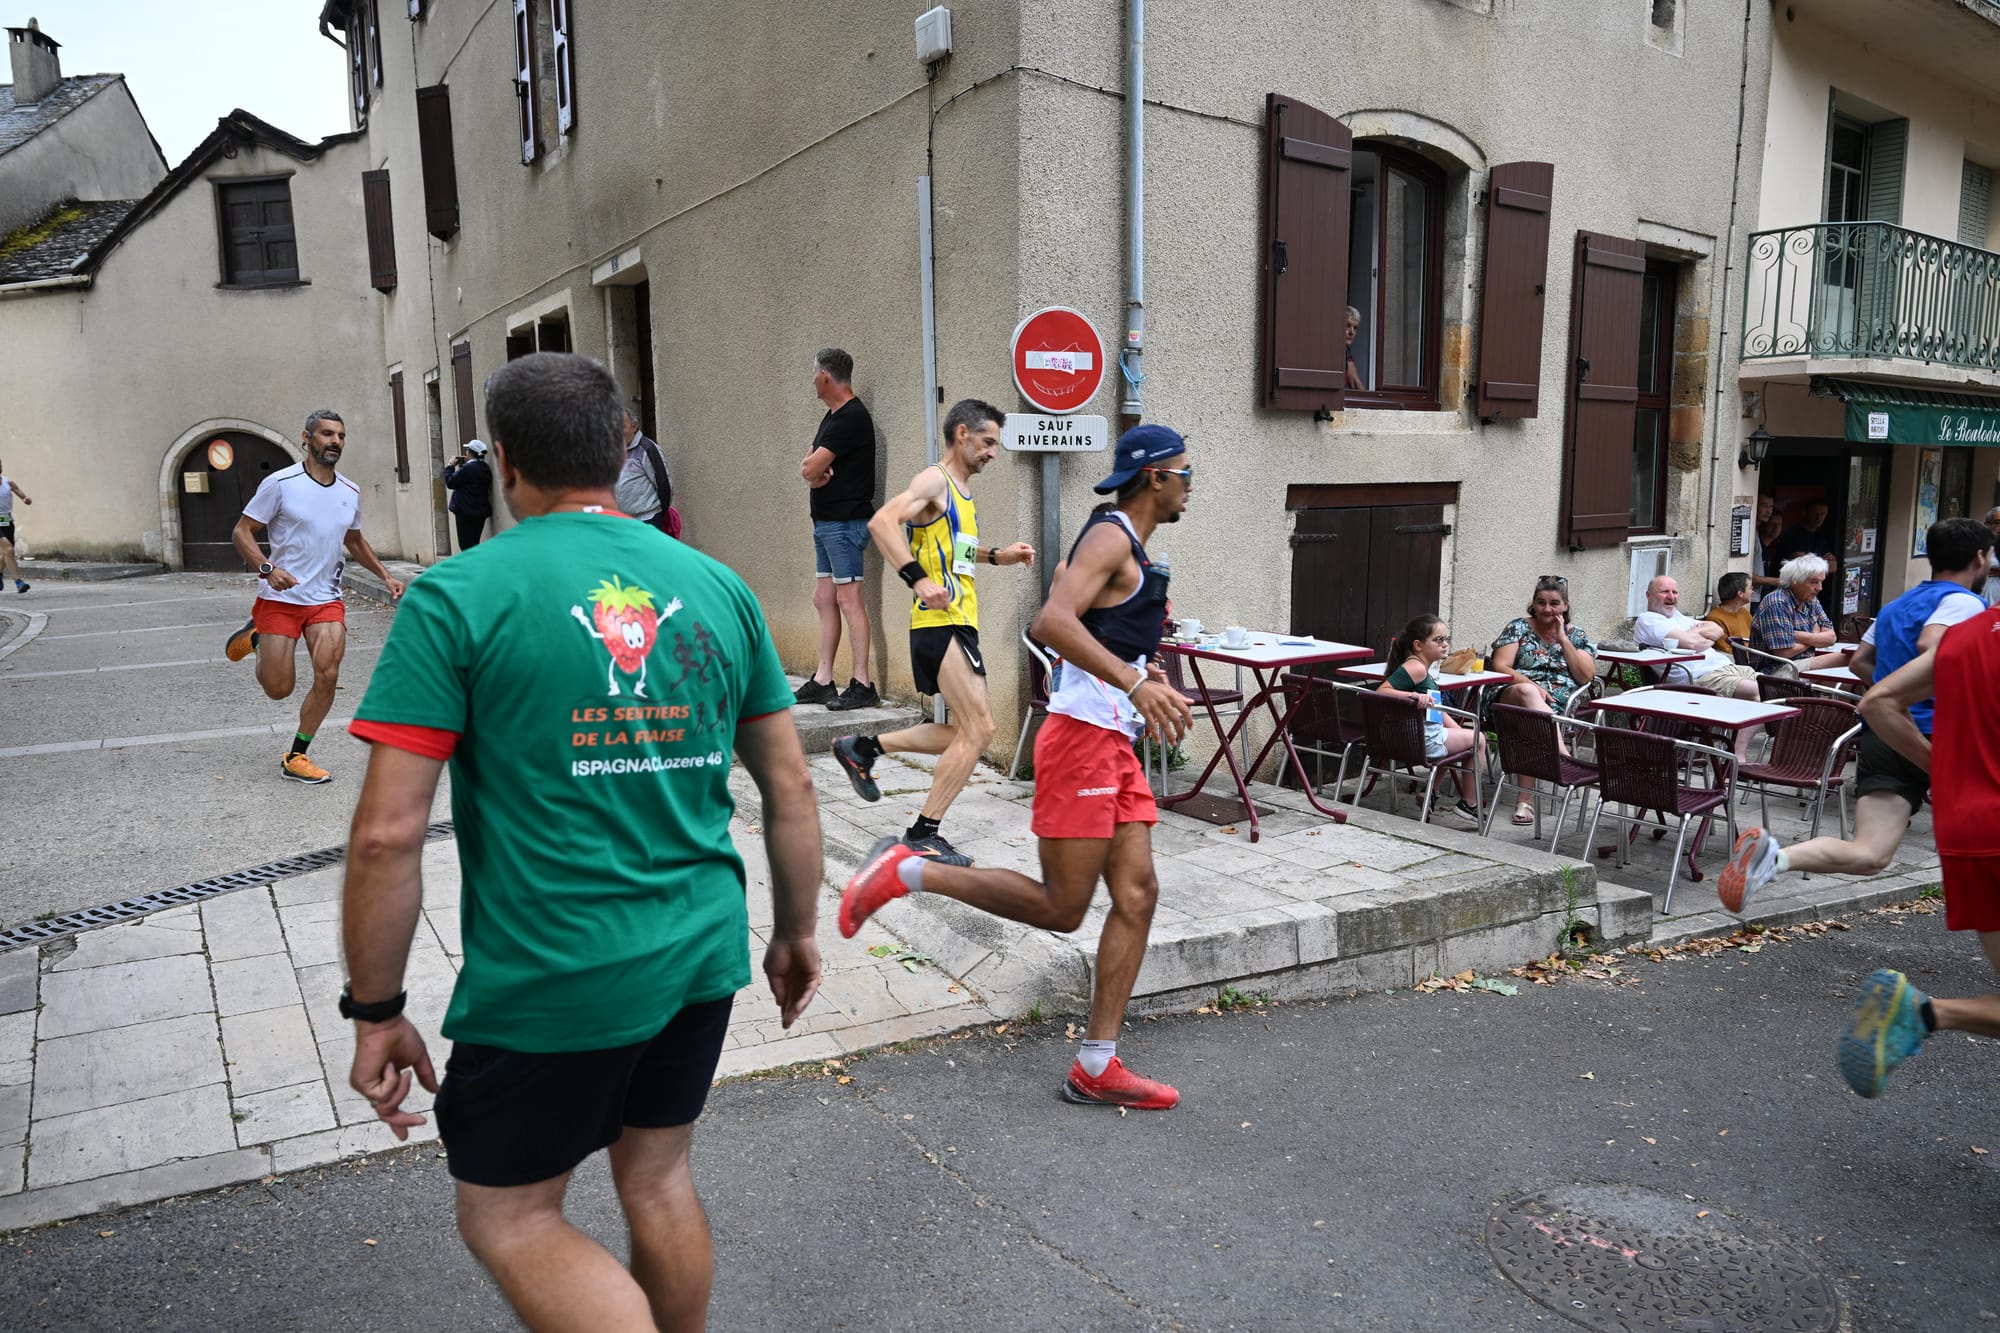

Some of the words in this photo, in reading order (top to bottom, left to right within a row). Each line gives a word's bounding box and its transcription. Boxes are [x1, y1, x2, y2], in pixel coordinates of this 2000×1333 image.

[1038, 420, 1073, 431] SAUF
[1937, 414, 1952, 441] Le
[1018, 434, 1092, 446] RIVERAINS
[572, 707, 608, 723] LES
[613, 705, 690, 721] SENTIERS
[572, 732, 599, 747] DE
[604, 731, 629, 745] LA
[706, 751, 723, 766] 48
